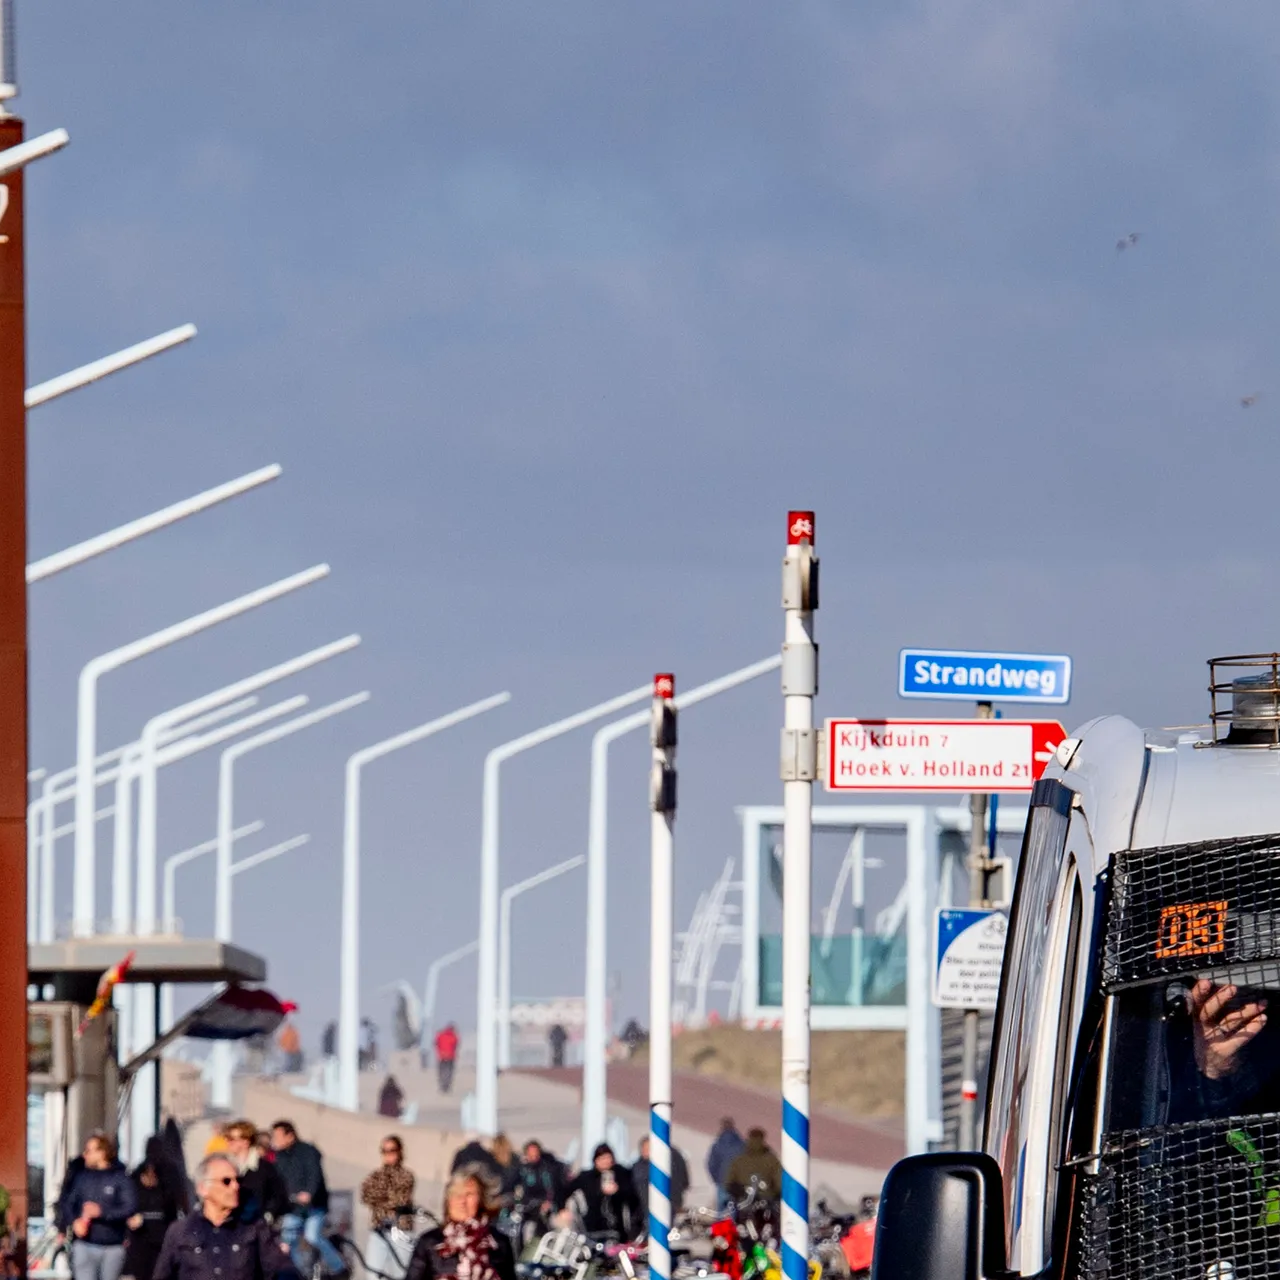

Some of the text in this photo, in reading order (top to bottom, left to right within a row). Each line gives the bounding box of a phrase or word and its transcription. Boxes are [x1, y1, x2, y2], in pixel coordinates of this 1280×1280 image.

[913, 659, 1057, 696] Strandweg
[841, 730, 949, 751] Kijkduin 7
[841, 760, 1030, 777] Hoek v. Holland 21
